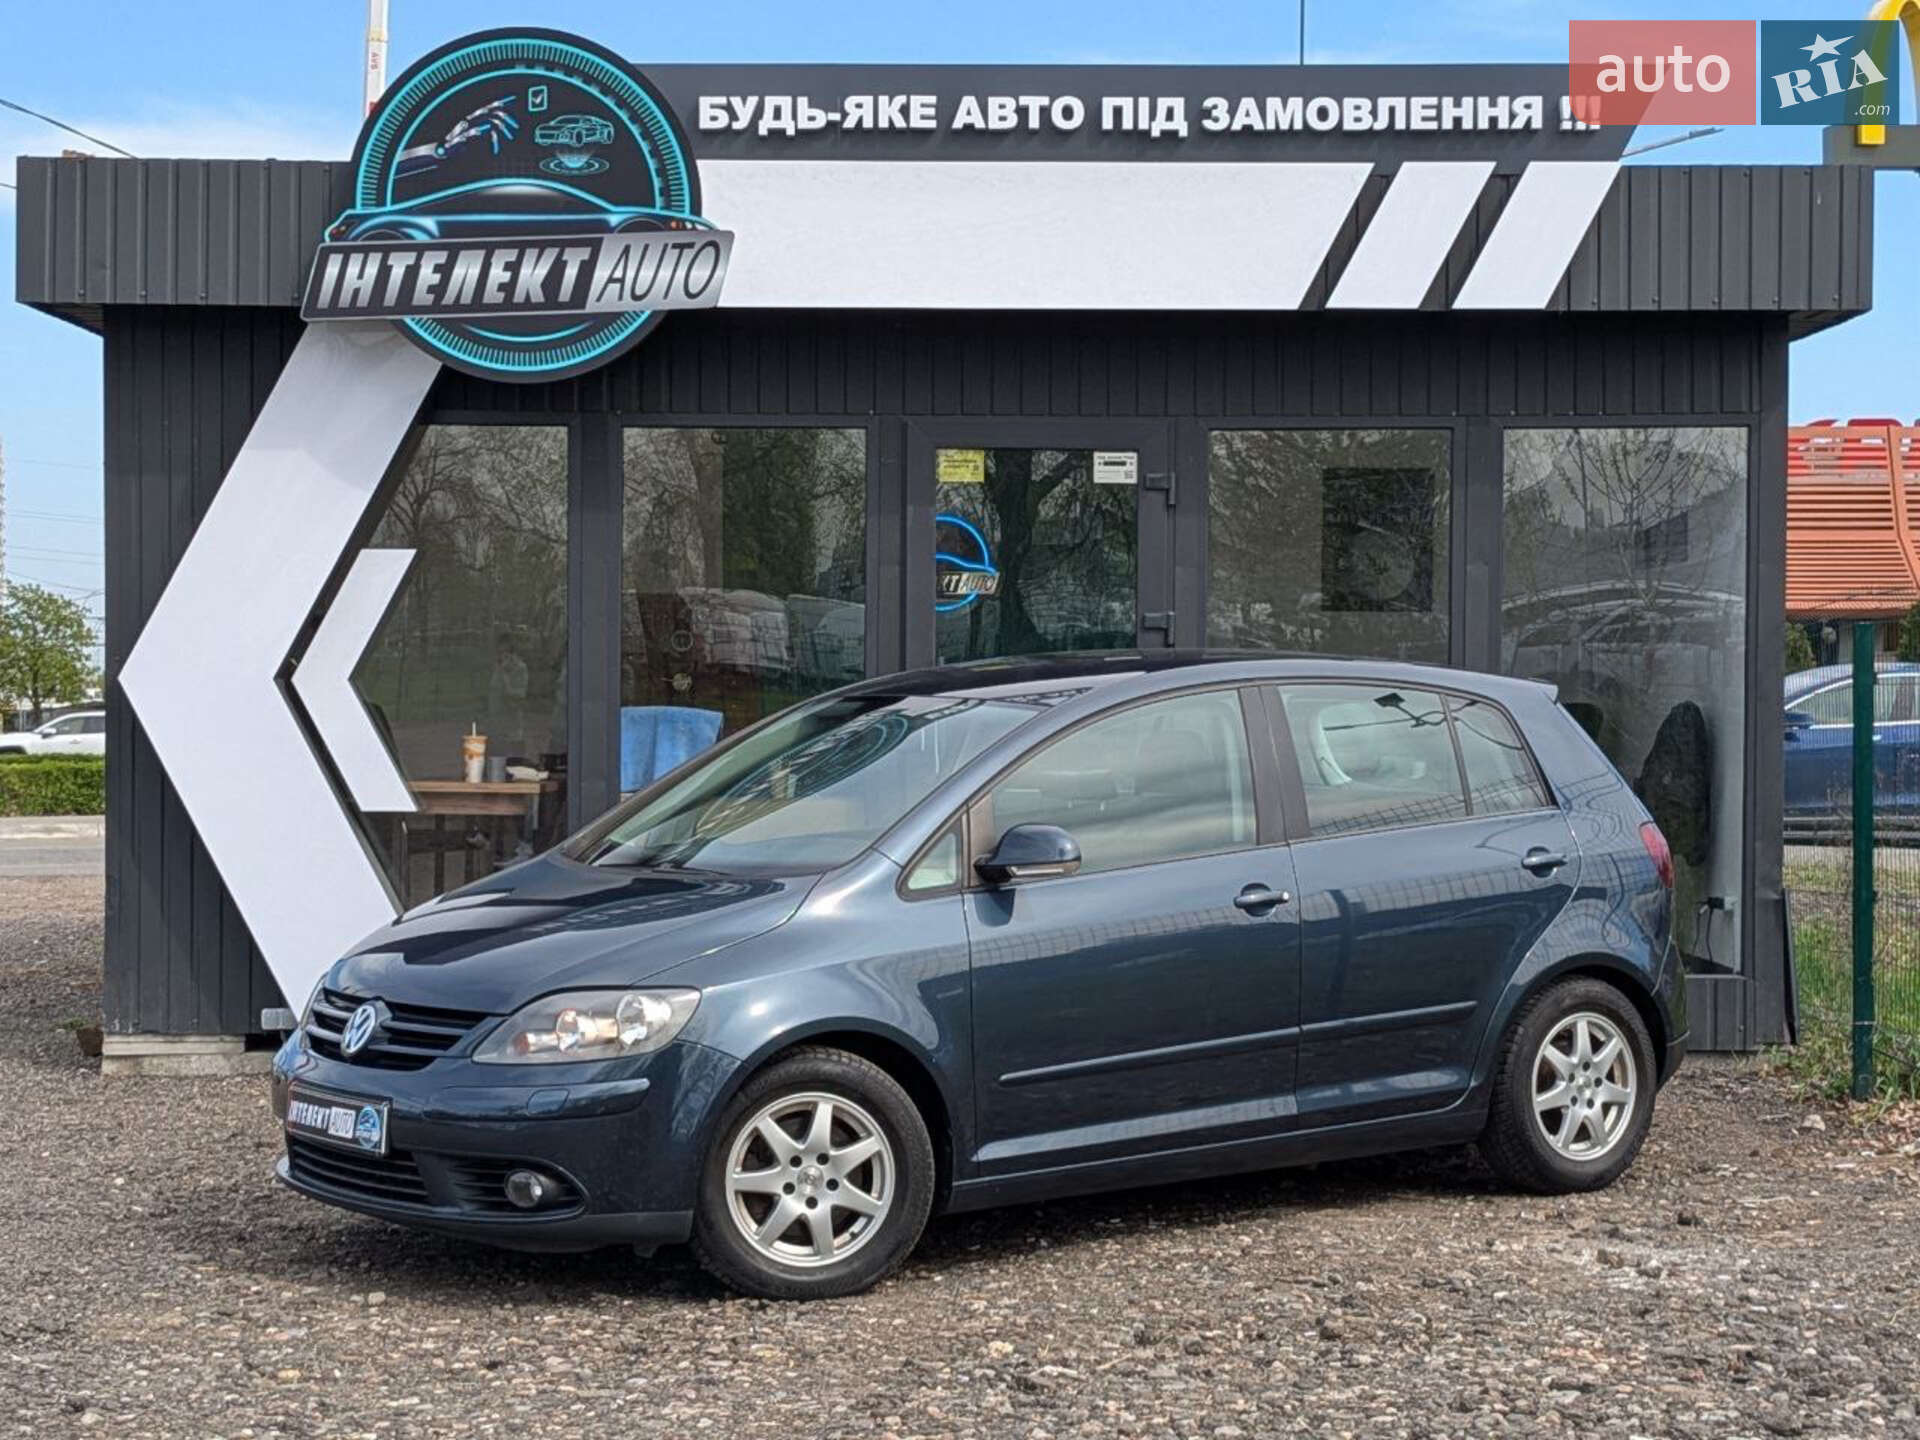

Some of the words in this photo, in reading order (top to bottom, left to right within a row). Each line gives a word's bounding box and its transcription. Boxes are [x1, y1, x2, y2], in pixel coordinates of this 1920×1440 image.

[699, 96, 937, 137] БУДЬ-ЯКЕ
[952, 97, 1086, 131] АВТО
[1101, 97, 1188, 138] ПІД
[1201, 96, 1544, 132] ЗАМОВЛЕННЯ
[316, 246, 589, 309] ІНТЕЛЕКТ
[596, 239, 720, 302] AUTO
